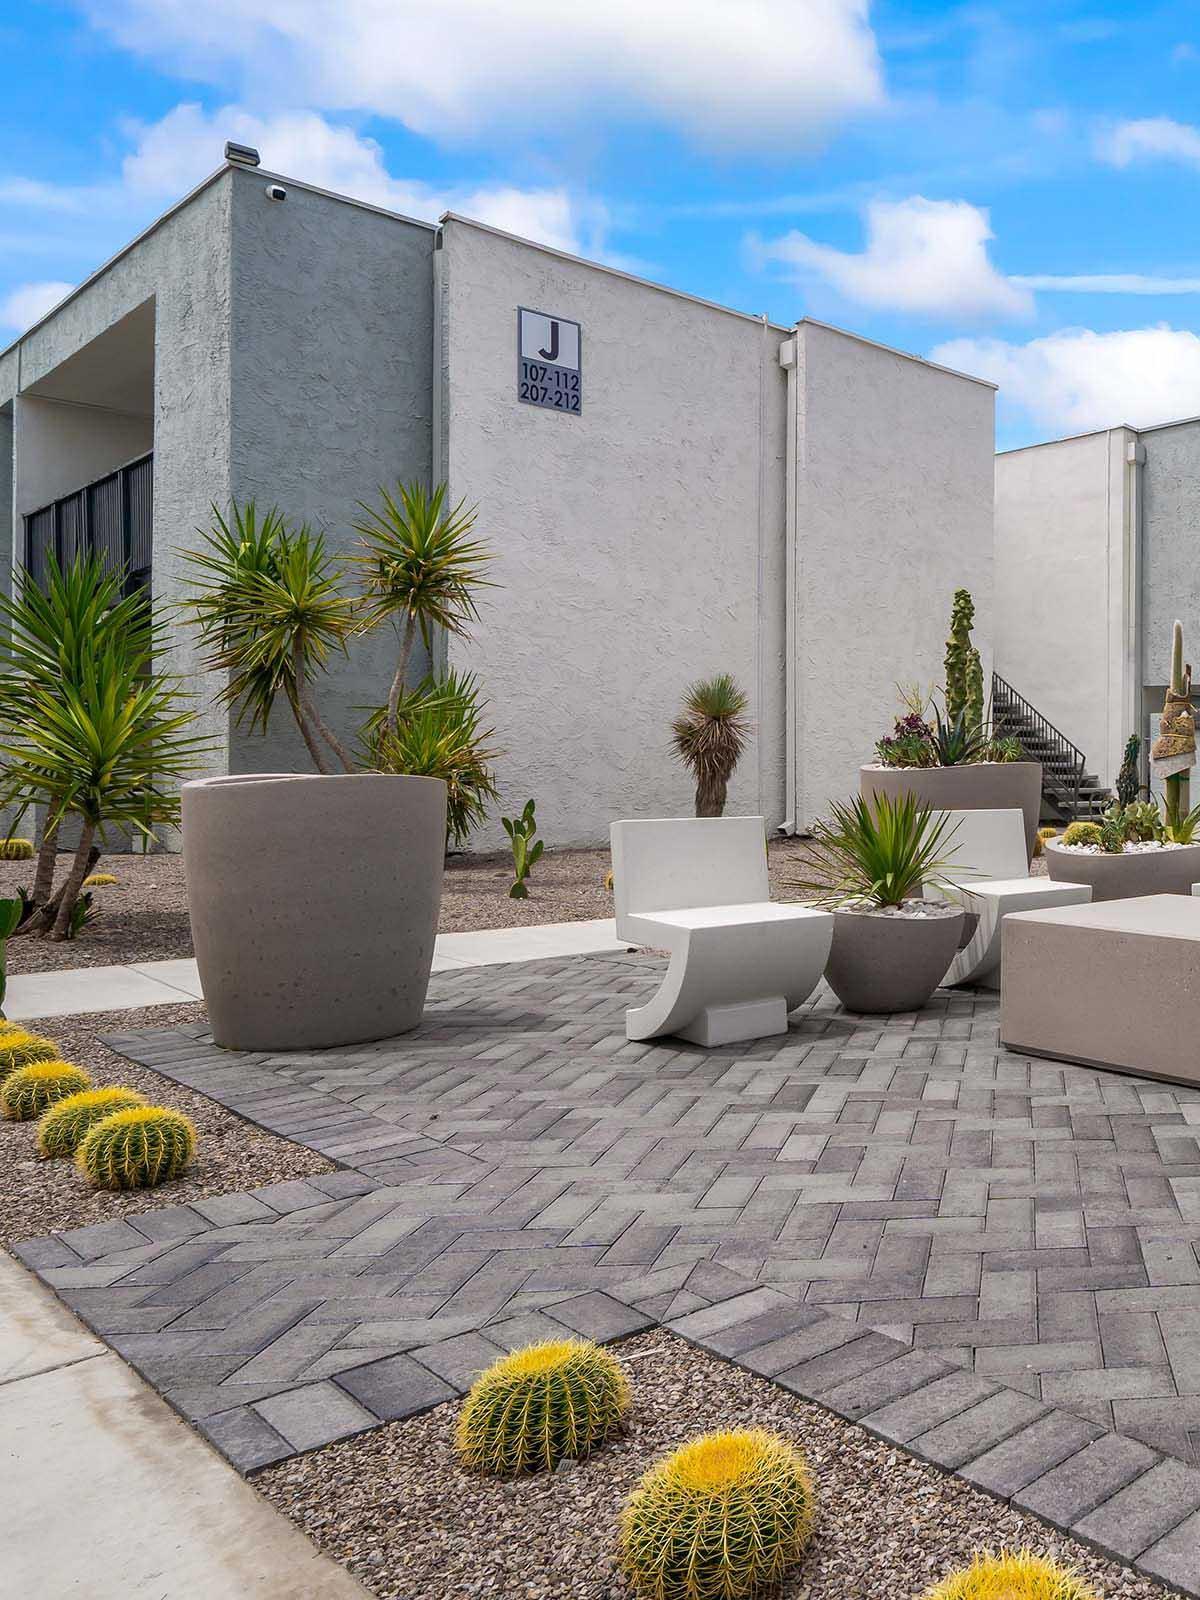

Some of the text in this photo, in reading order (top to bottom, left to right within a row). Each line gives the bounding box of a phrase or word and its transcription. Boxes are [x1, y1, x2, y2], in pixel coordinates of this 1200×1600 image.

[538, 321, 559, 361] J
[522, 362, 579, 391] 107-112
[520, 382, 579, 411] 207-212
